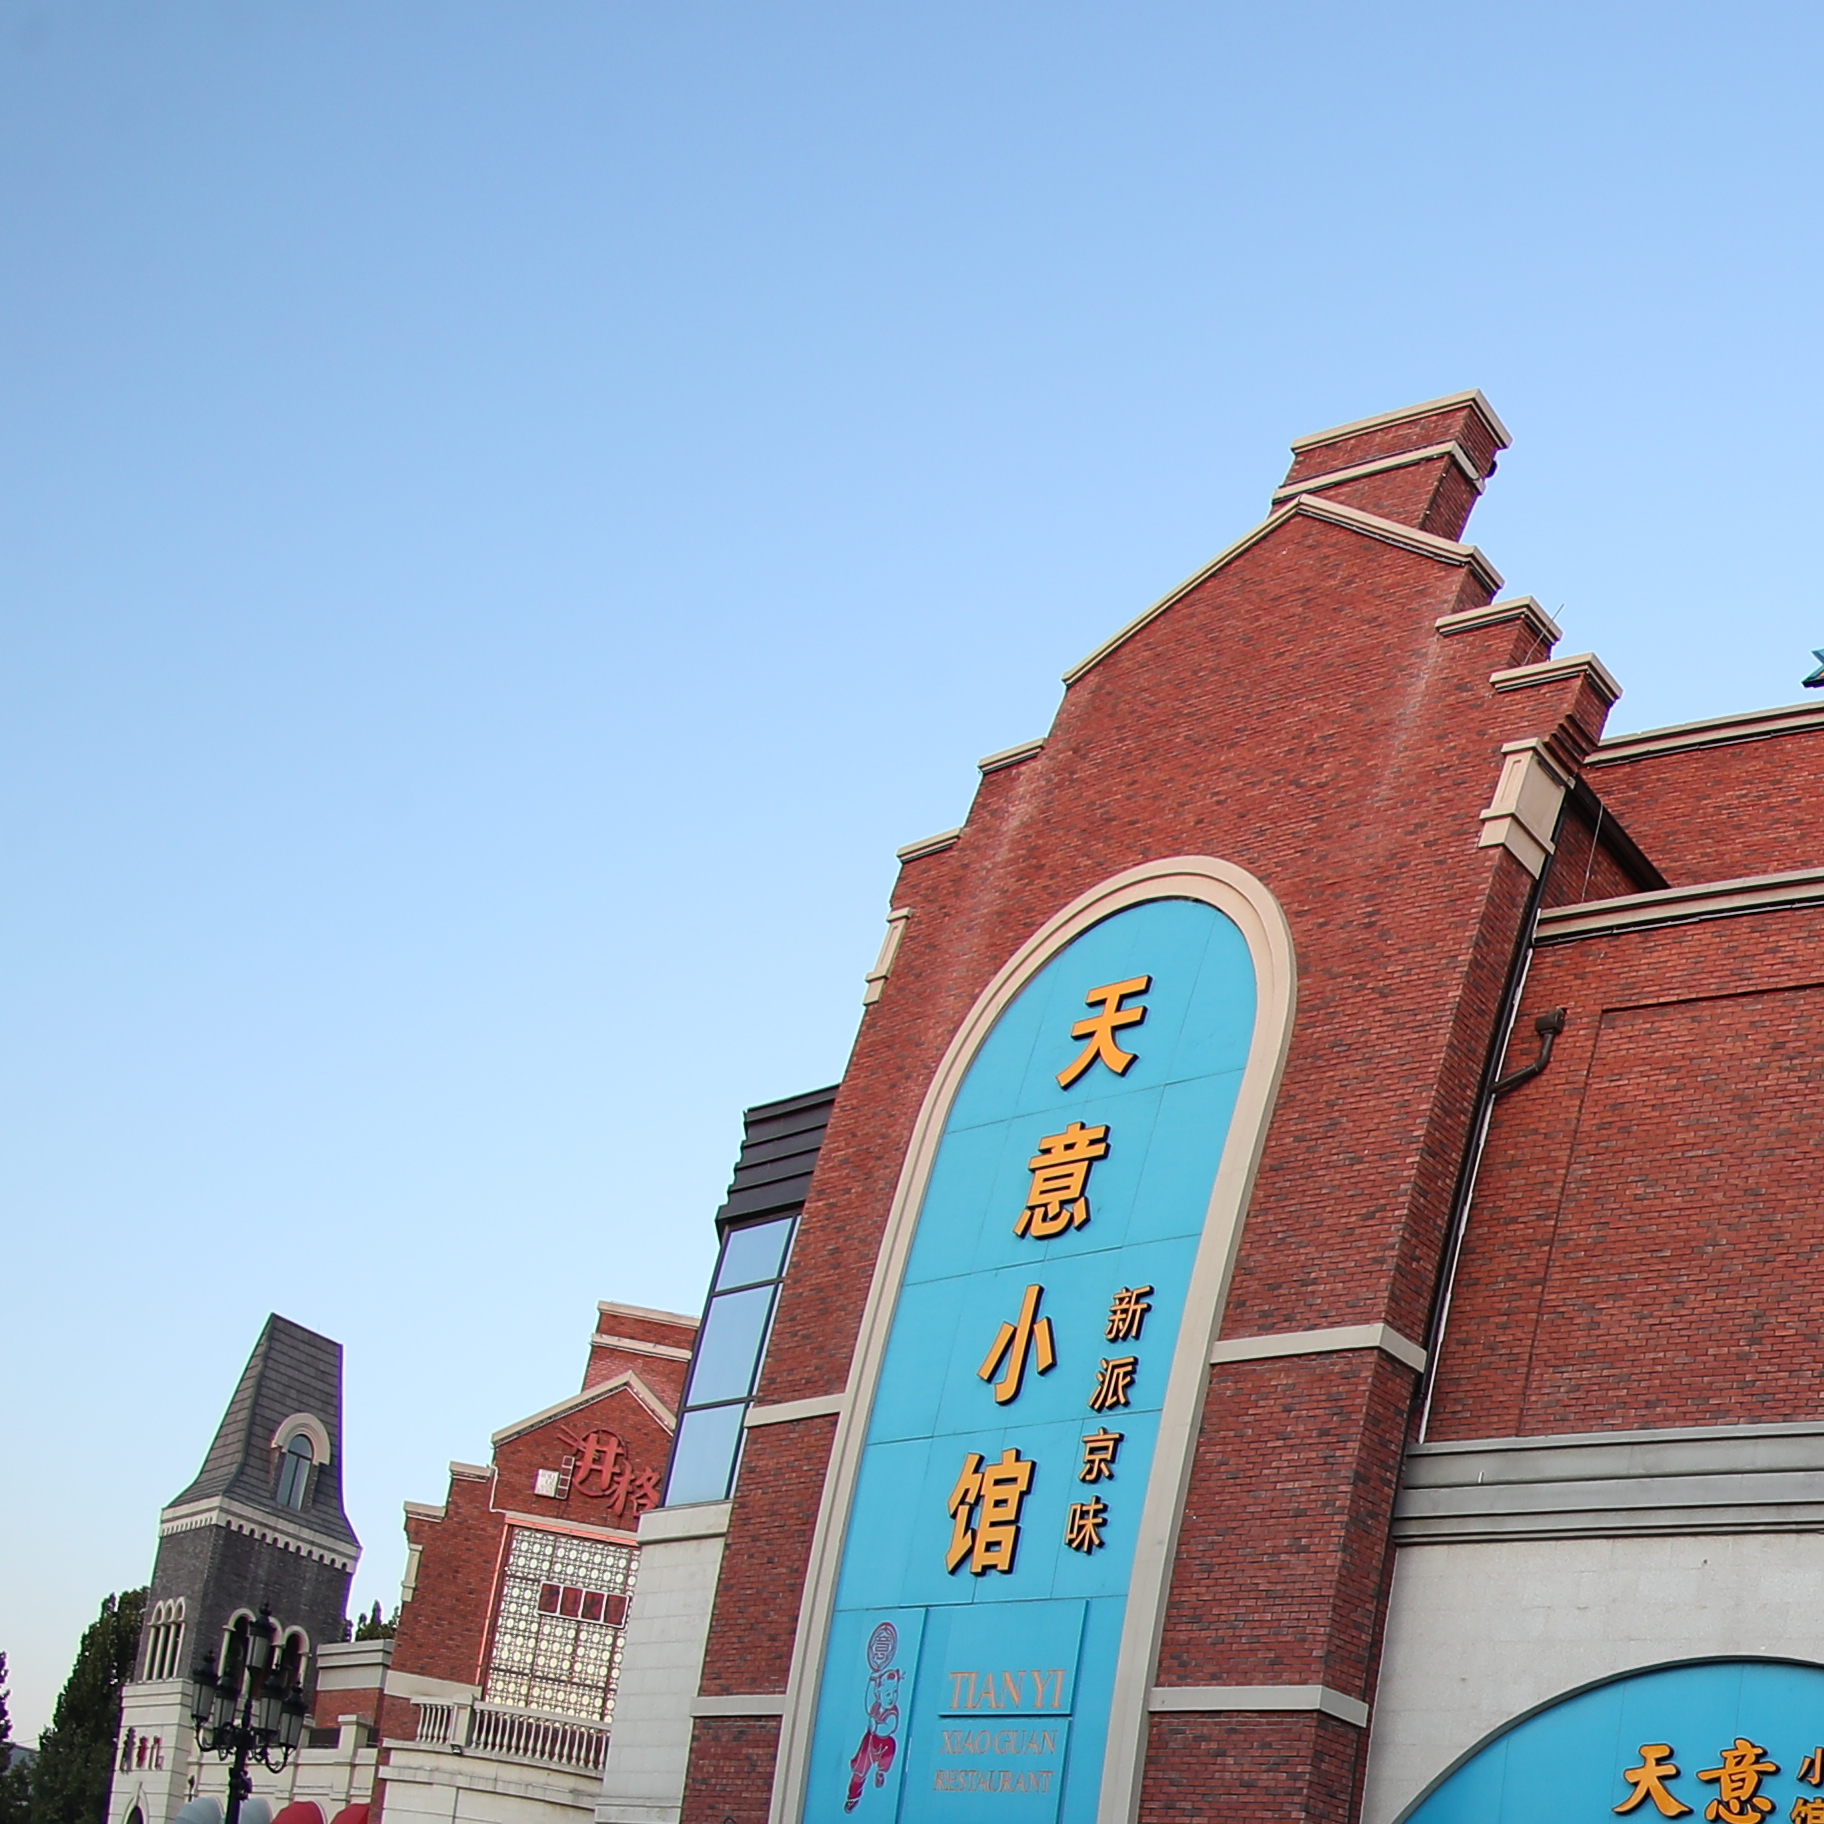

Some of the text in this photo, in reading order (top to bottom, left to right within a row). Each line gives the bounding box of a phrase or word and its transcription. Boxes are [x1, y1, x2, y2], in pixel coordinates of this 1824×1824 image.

[944, 974, 1153, 1577] 天意小馆
[1063, 1283, 1155, 1554] 新派京味
[948, 1669, 1067, 1710] TIAN YI
[941, 1729, 1059, 1755] XIAO GUAN
[932, 1769, 1055, 1795] RESTAURANT
